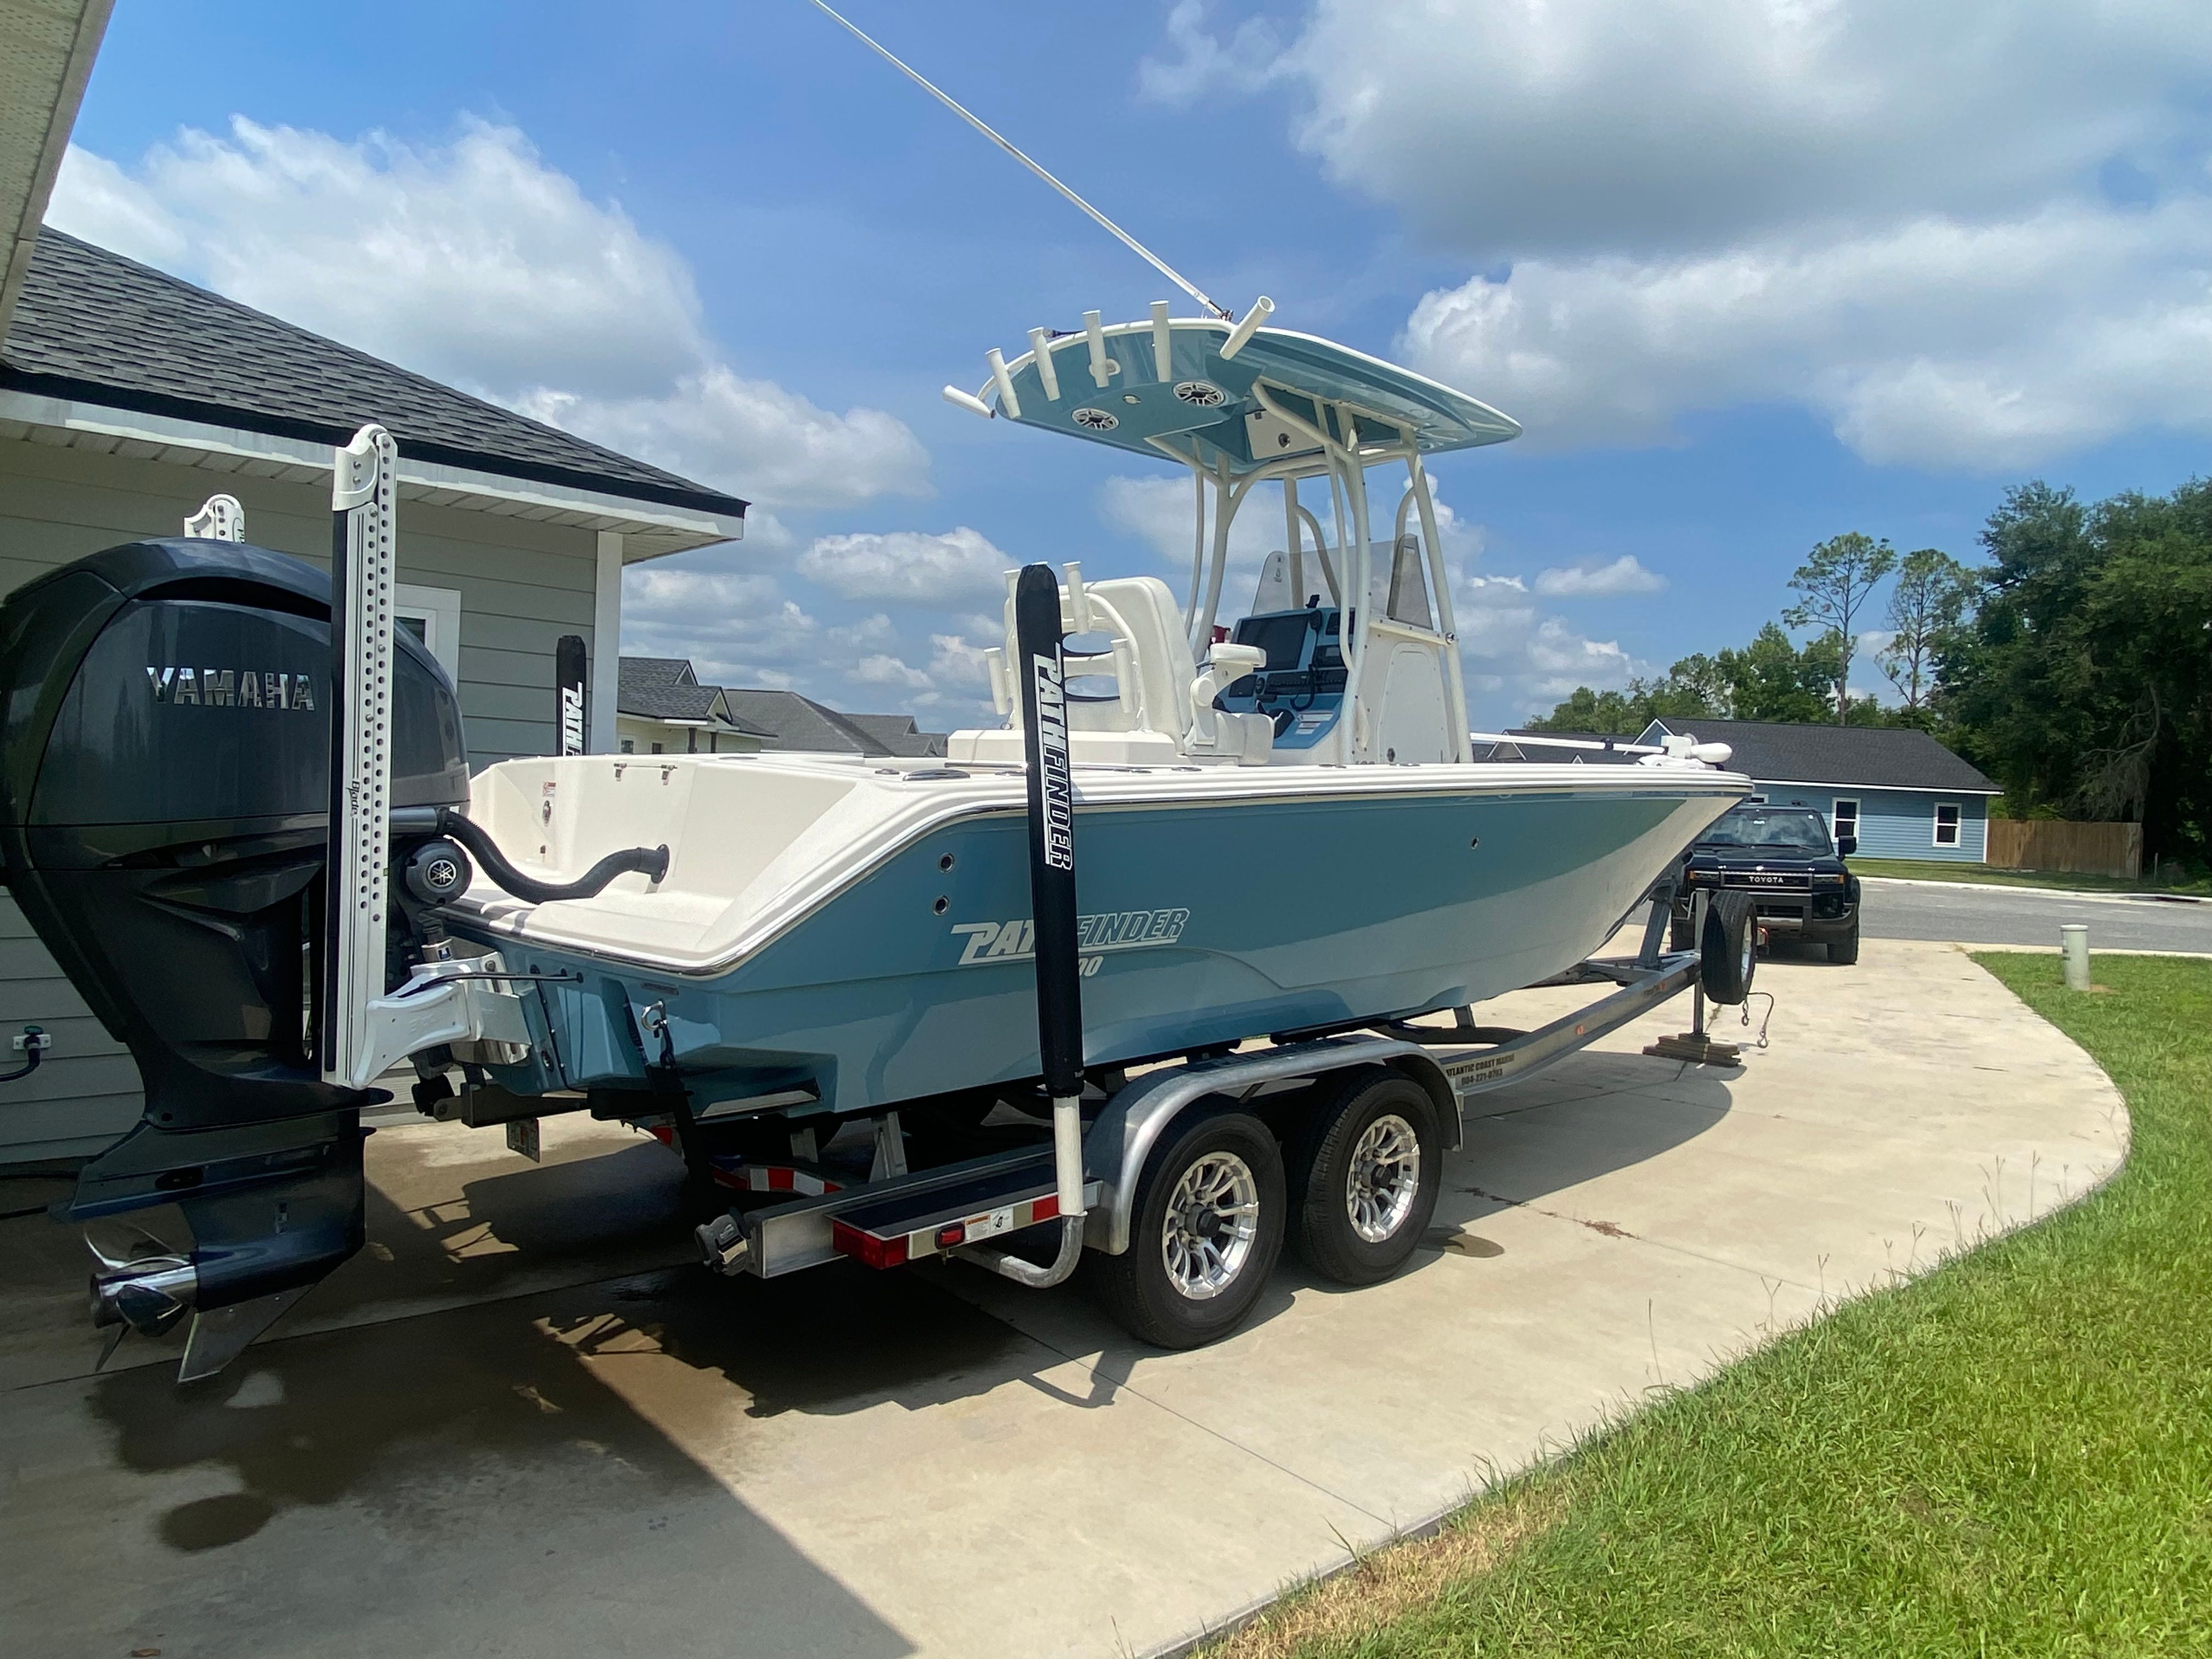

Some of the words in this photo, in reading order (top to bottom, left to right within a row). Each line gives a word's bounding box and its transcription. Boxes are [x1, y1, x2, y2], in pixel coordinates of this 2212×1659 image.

[146, 667, 315, 711] YAMAHA
[1034, 642, 1073, 871] PATHFINDER
[1476, 1059, 1495, 1070] COAST
